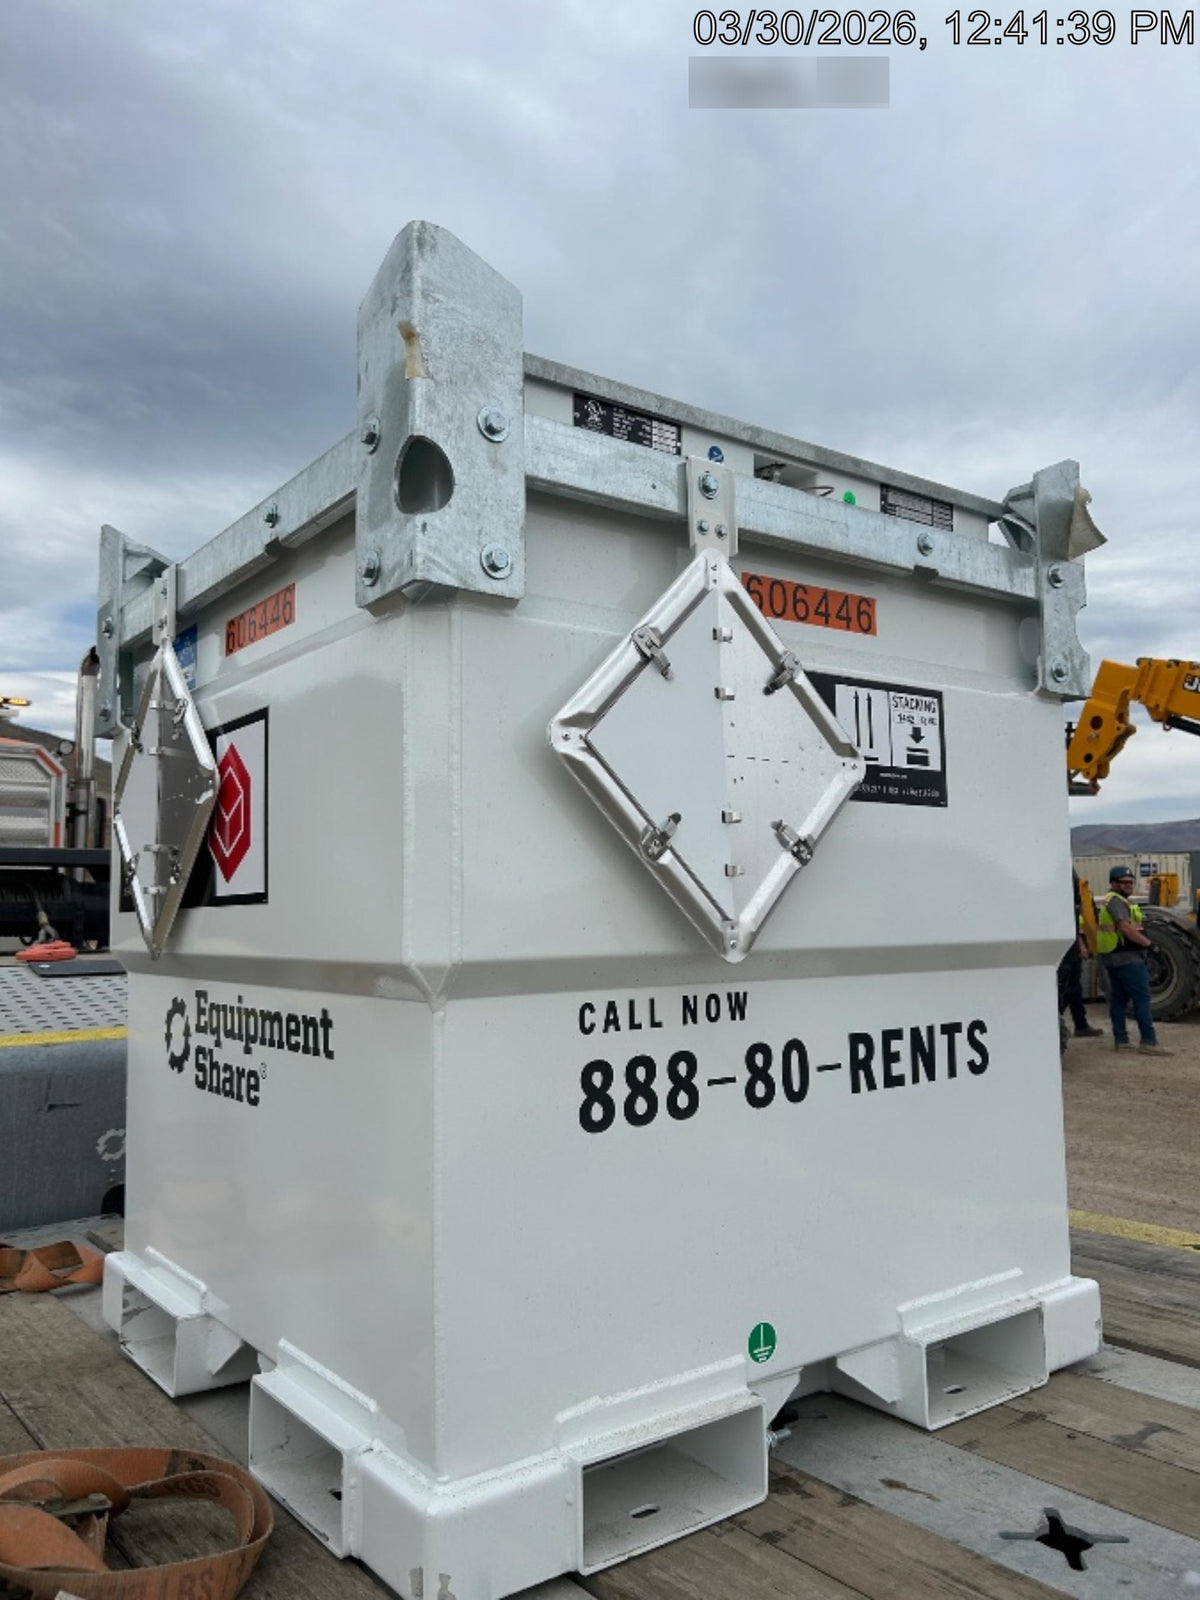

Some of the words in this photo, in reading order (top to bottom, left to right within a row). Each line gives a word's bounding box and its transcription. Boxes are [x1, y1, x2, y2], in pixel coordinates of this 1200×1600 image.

[226, 588, 293, 655] 606446
[746, 574, 872, 635] 606446
[194, 989, 335, 1060] Equipment
[578, 996, 663, 1036] CALL
[681, 991, 748, 1027] NOW
[578, 1018, 990, 1134] 888-80-RENTS
